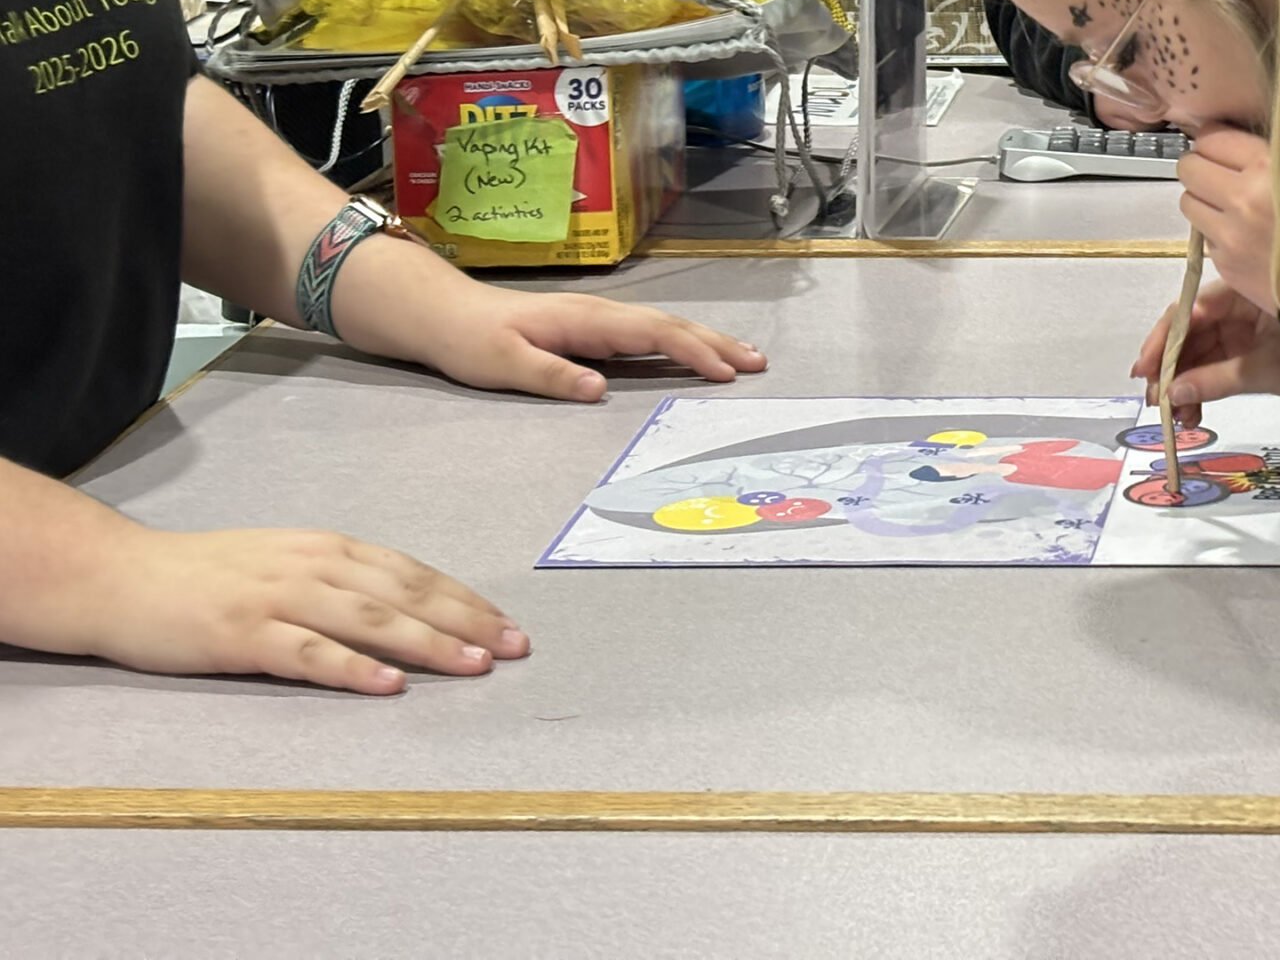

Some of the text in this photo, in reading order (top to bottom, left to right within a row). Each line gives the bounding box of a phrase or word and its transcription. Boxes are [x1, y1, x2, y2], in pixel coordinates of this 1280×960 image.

[27, 29, 141, 94] 2025-2026
[568, 77, 603, 100] 30
[567, 100, 606, 112] PACKS
[457, 130, 520, 163] Vaping
[464, 160, 526, 195] (New)
[446, 201, 544, 222] 2 activities
